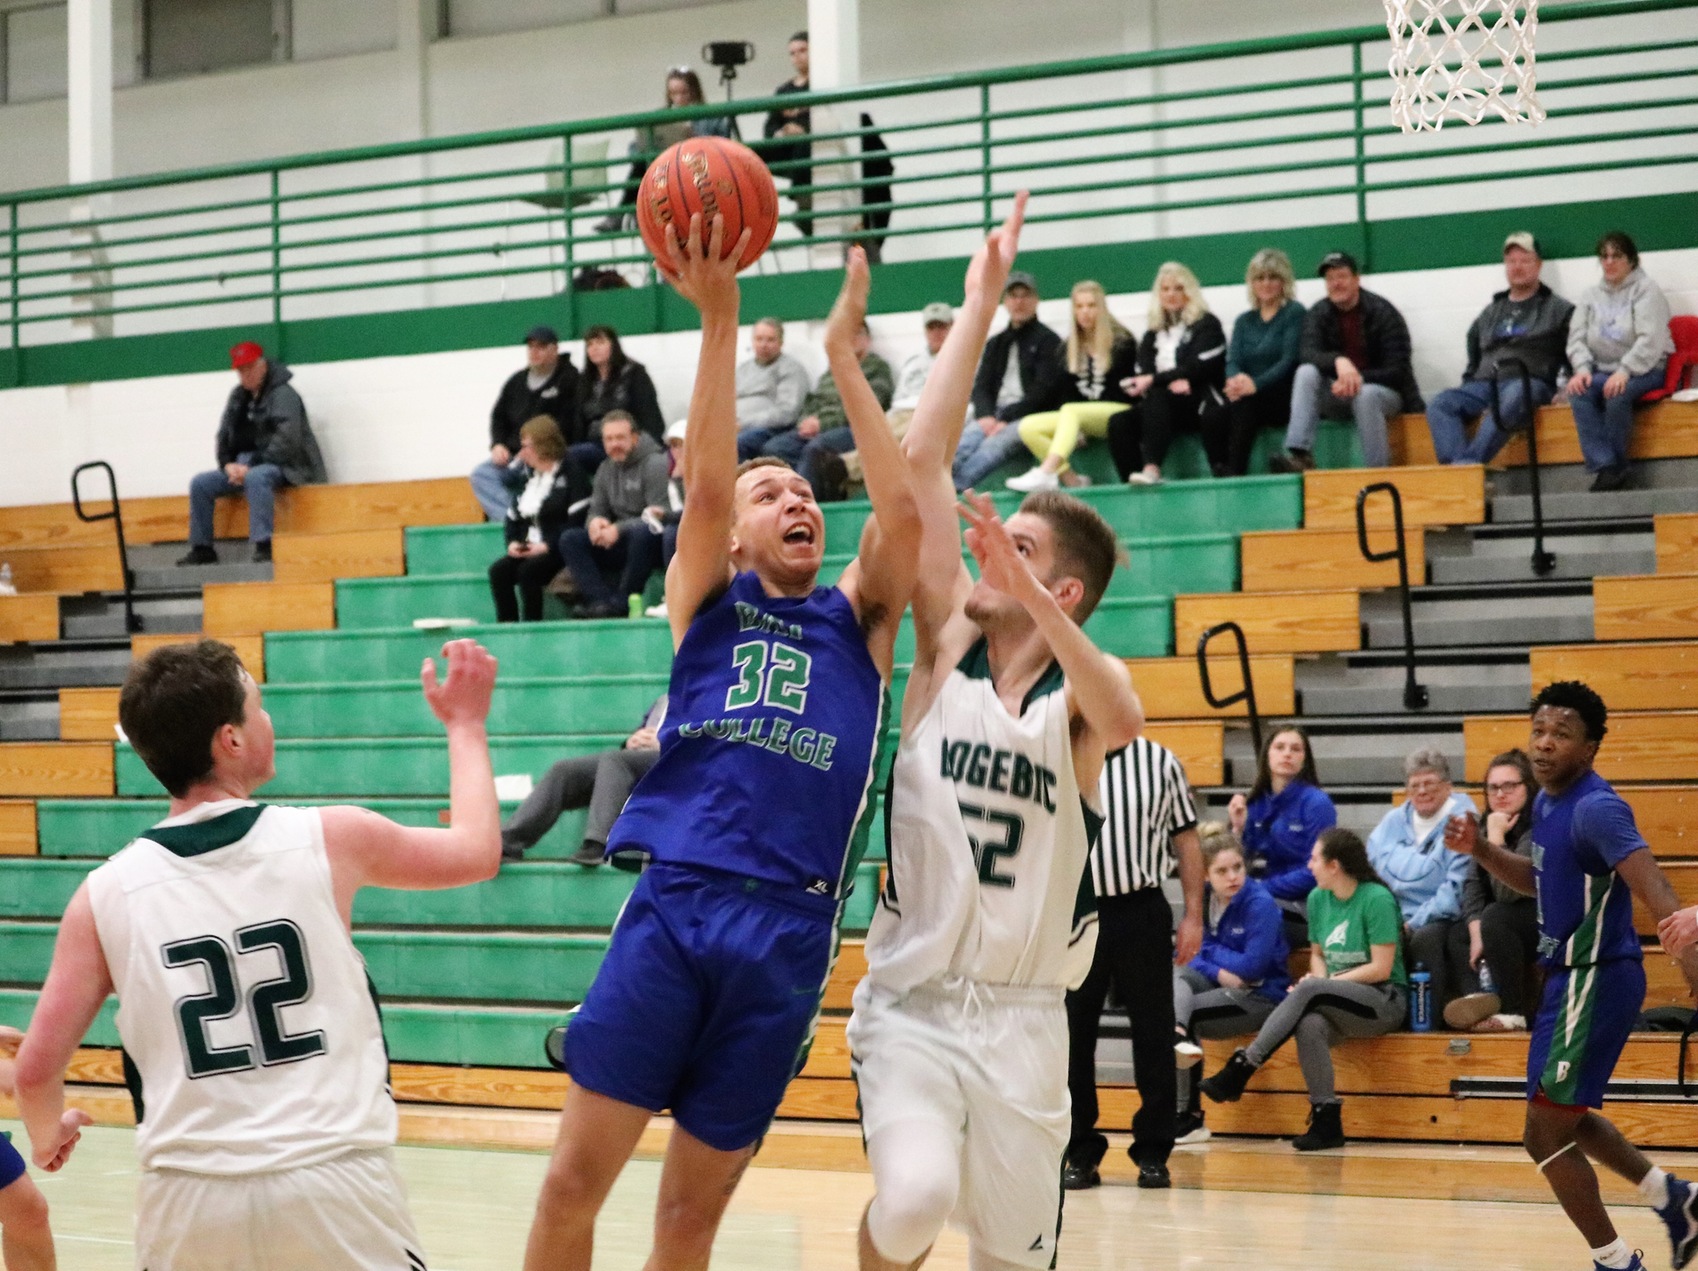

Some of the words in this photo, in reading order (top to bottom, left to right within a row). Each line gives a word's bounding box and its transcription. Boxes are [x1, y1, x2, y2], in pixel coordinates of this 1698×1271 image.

[724, 640, 812, 715] 32
[160, 918, 328, 1080] 22
[1555, 1061, 1571, 1084] B
